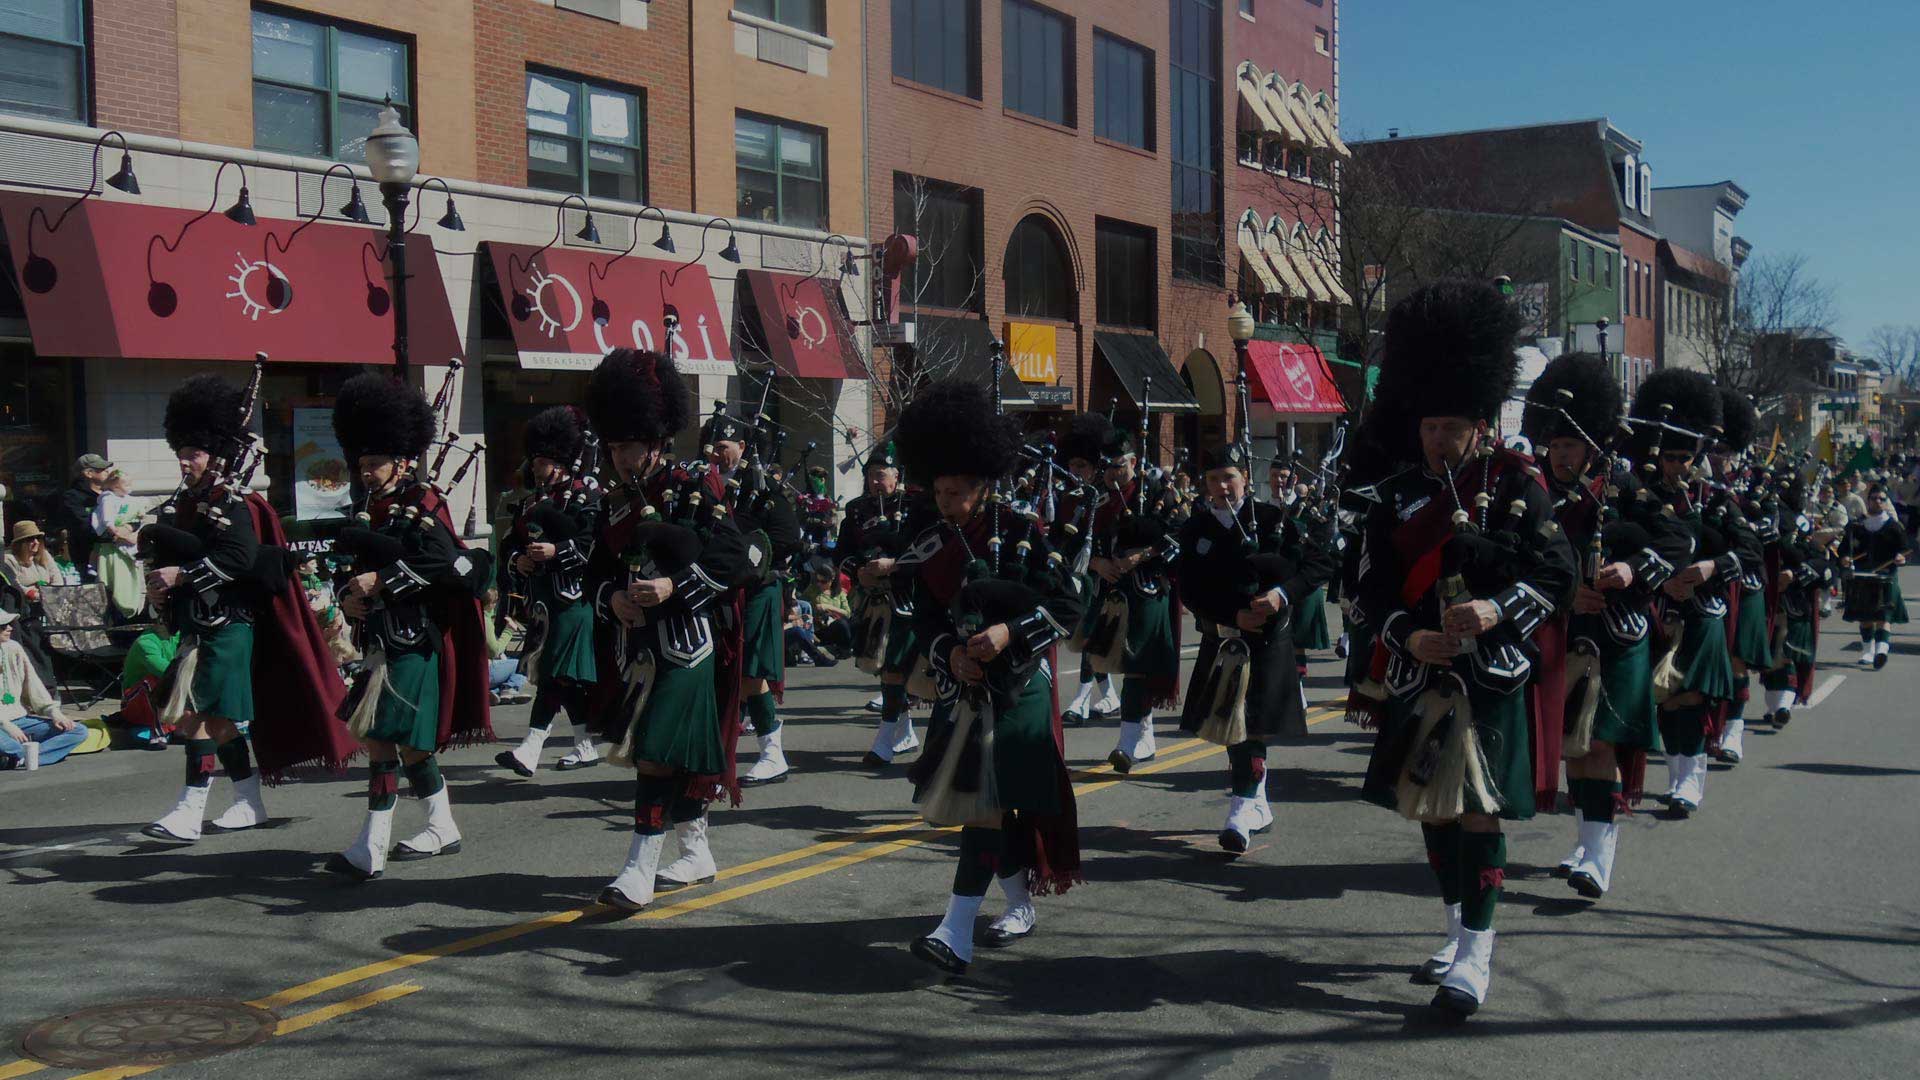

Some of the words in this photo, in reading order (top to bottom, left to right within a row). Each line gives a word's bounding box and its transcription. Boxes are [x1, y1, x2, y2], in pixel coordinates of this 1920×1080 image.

[532, 356, 593, 367] BREAKFAST
[1011, 352, 1056, 379] VILLA
[286, 539, 336, 553] AKFAST
